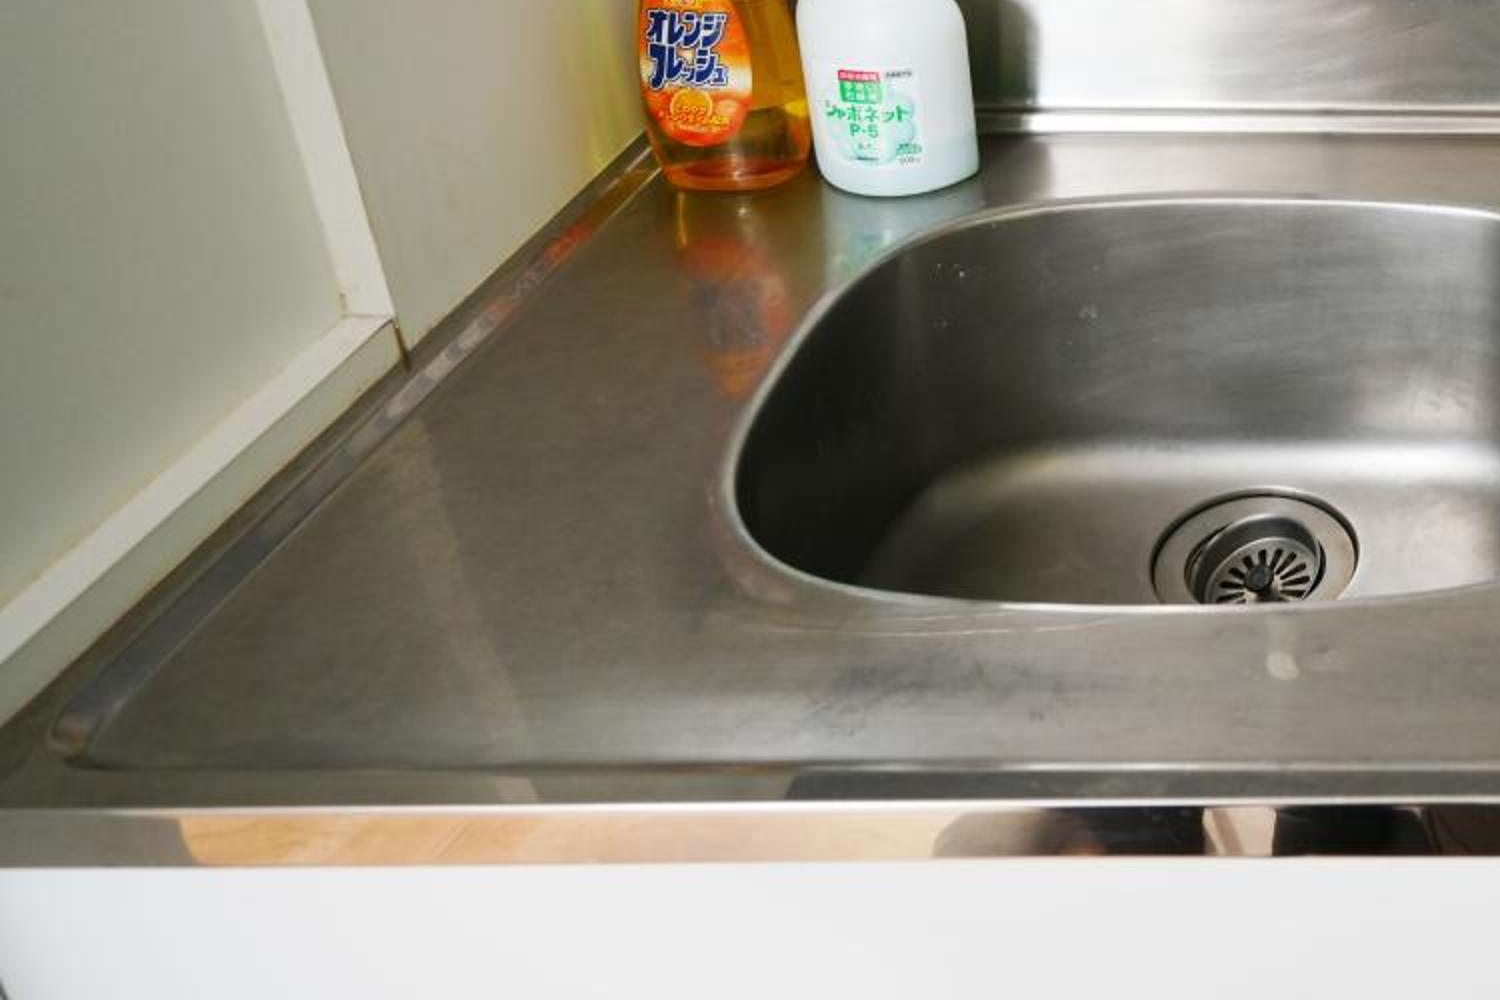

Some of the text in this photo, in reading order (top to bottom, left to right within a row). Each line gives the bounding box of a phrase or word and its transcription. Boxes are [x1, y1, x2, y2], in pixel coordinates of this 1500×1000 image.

[647, 10, 728, 48] オレンジ
[649, 45, 729, 89] フレッシュ
